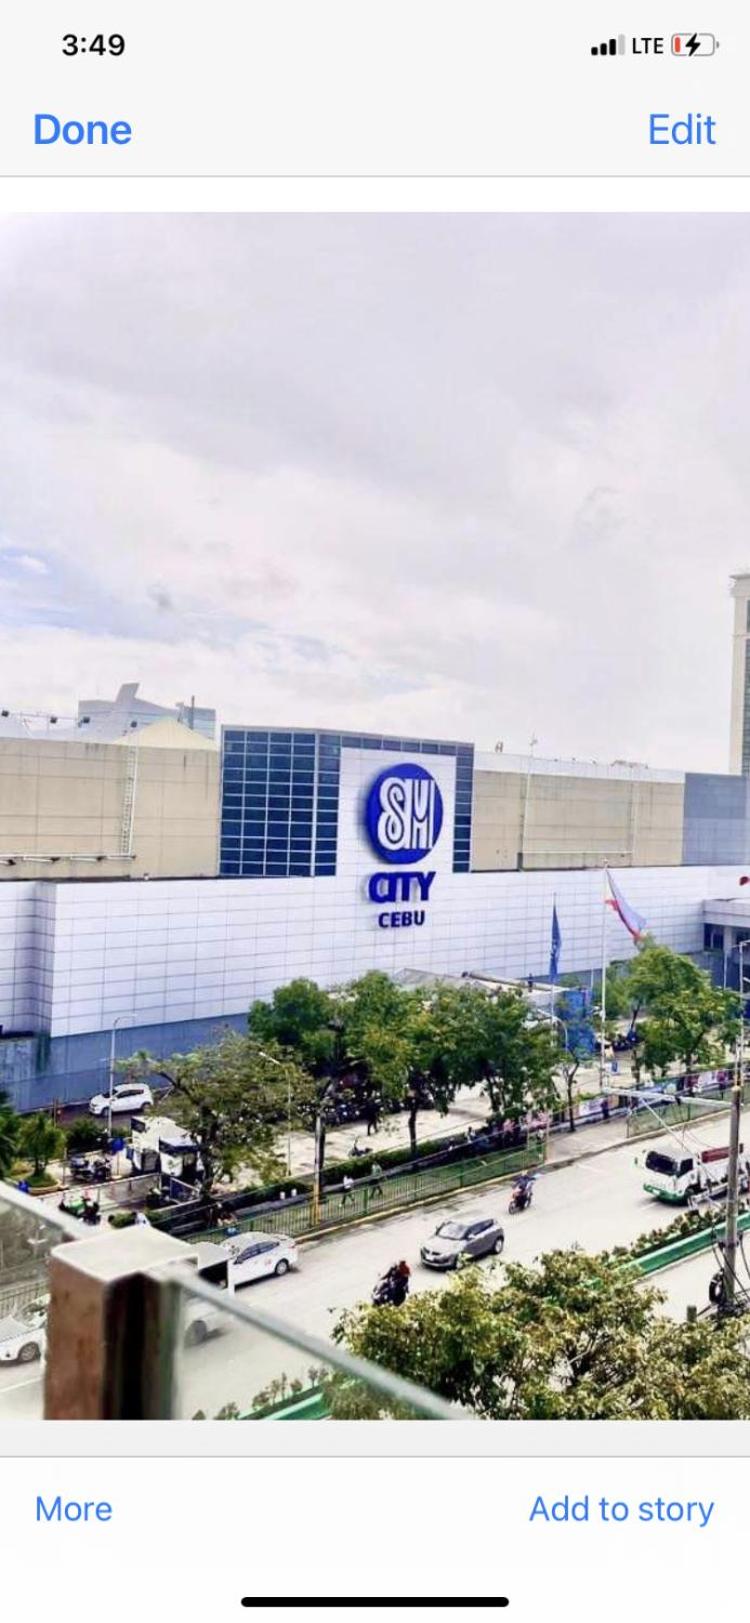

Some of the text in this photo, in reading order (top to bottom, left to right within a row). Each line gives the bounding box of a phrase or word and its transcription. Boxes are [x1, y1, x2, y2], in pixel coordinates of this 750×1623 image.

[377, 777, 435, 850] SM
[368, 871, 435, 904] CITY
[378, 911, 425, 928] CEBU
